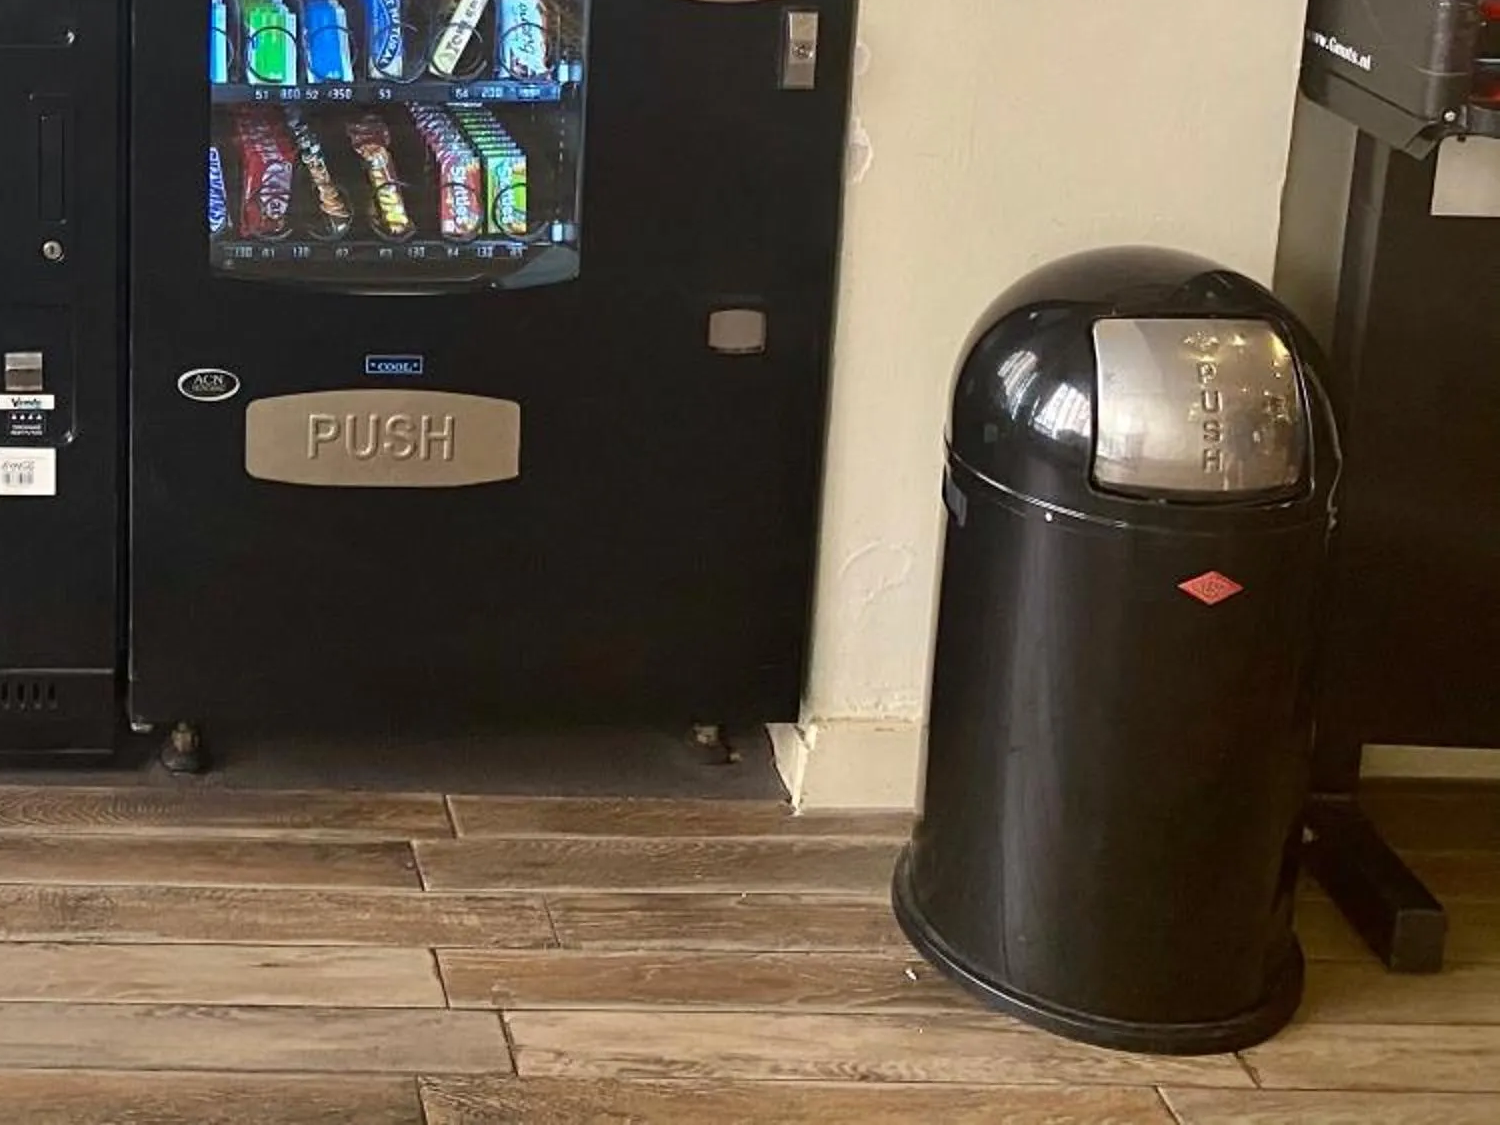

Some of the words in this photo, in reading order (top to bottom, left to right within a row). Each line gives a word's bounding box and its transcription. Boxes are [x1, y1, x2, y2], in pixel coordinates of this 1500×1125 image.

[192, 375, 224, 386] ACN
[307, 413, 455, 462] PUSH
[1198, 362, 1224, 473] PUSH
